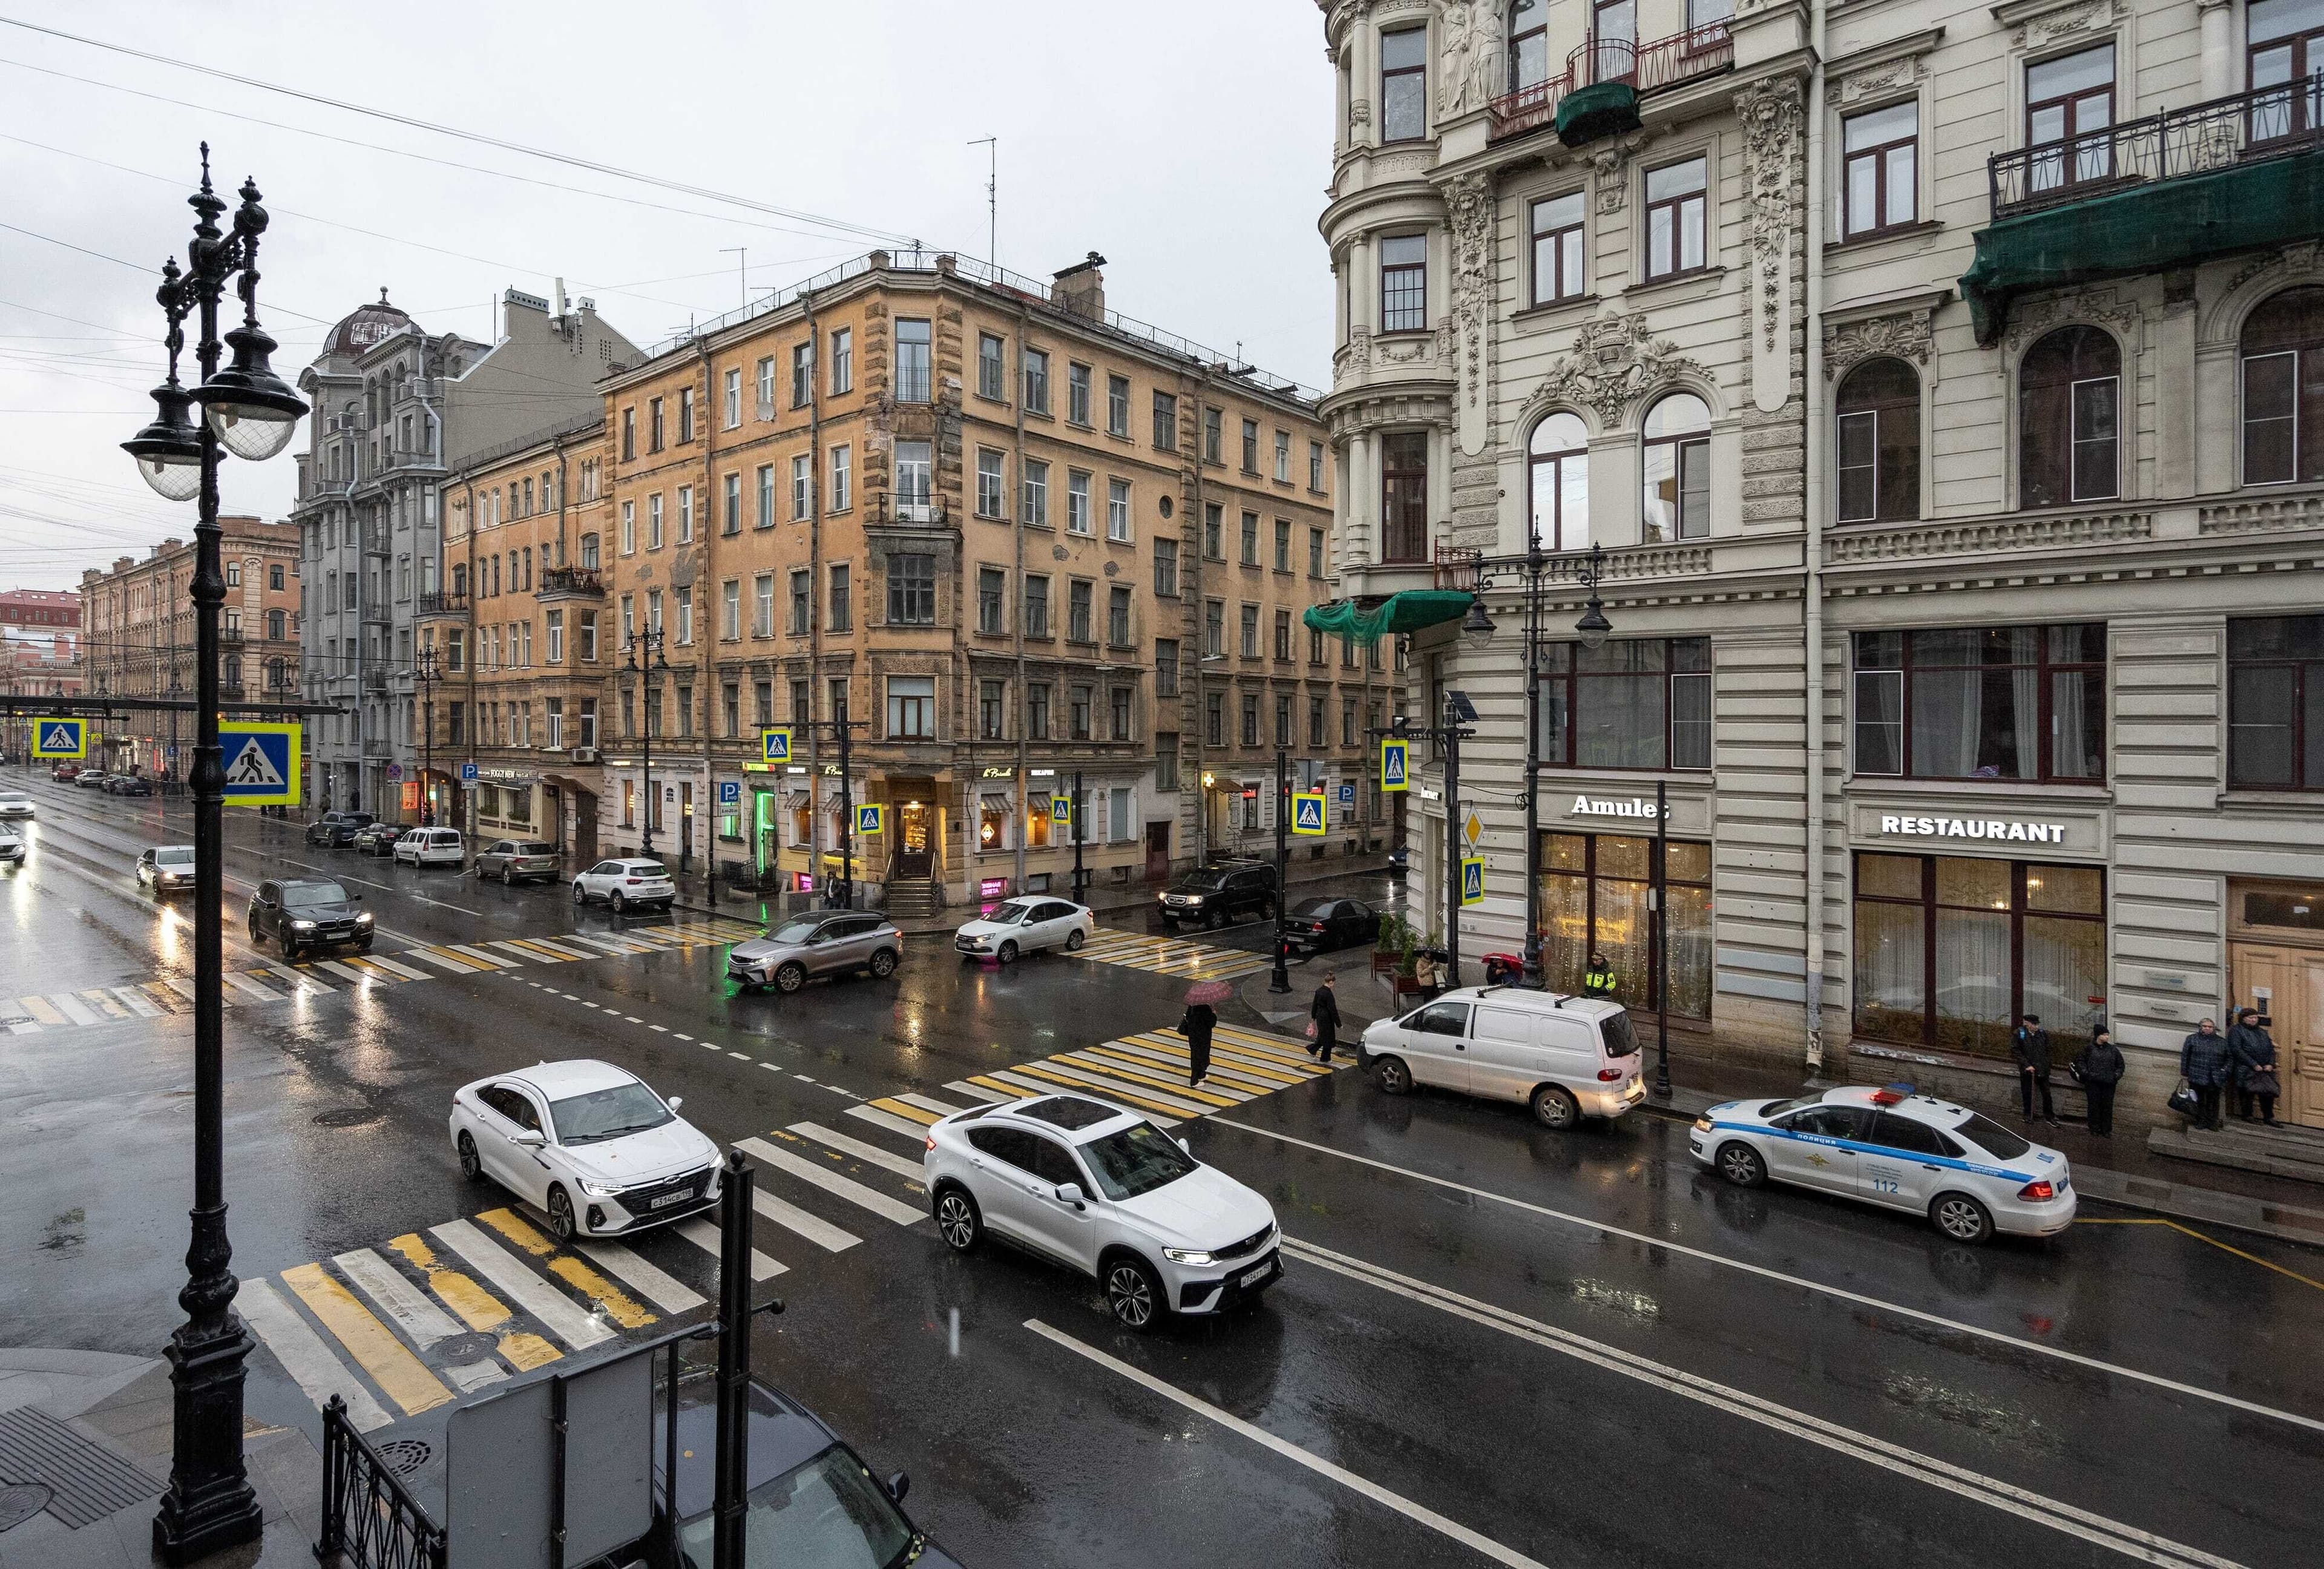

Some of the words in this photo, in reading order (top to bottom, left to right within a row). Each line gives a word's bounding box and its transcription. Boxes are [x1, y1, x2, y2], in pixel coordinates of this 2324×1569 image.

[491, 769, 504, 777] FOGGY
[505, 769, 515, 778] NEW
[1882, 815, 2065, 843] RESTAURANT
[1797, 1133, 1836, 1145] ПОЛИЦИЯ
[1874, 1179, 1898, 1194] 112
